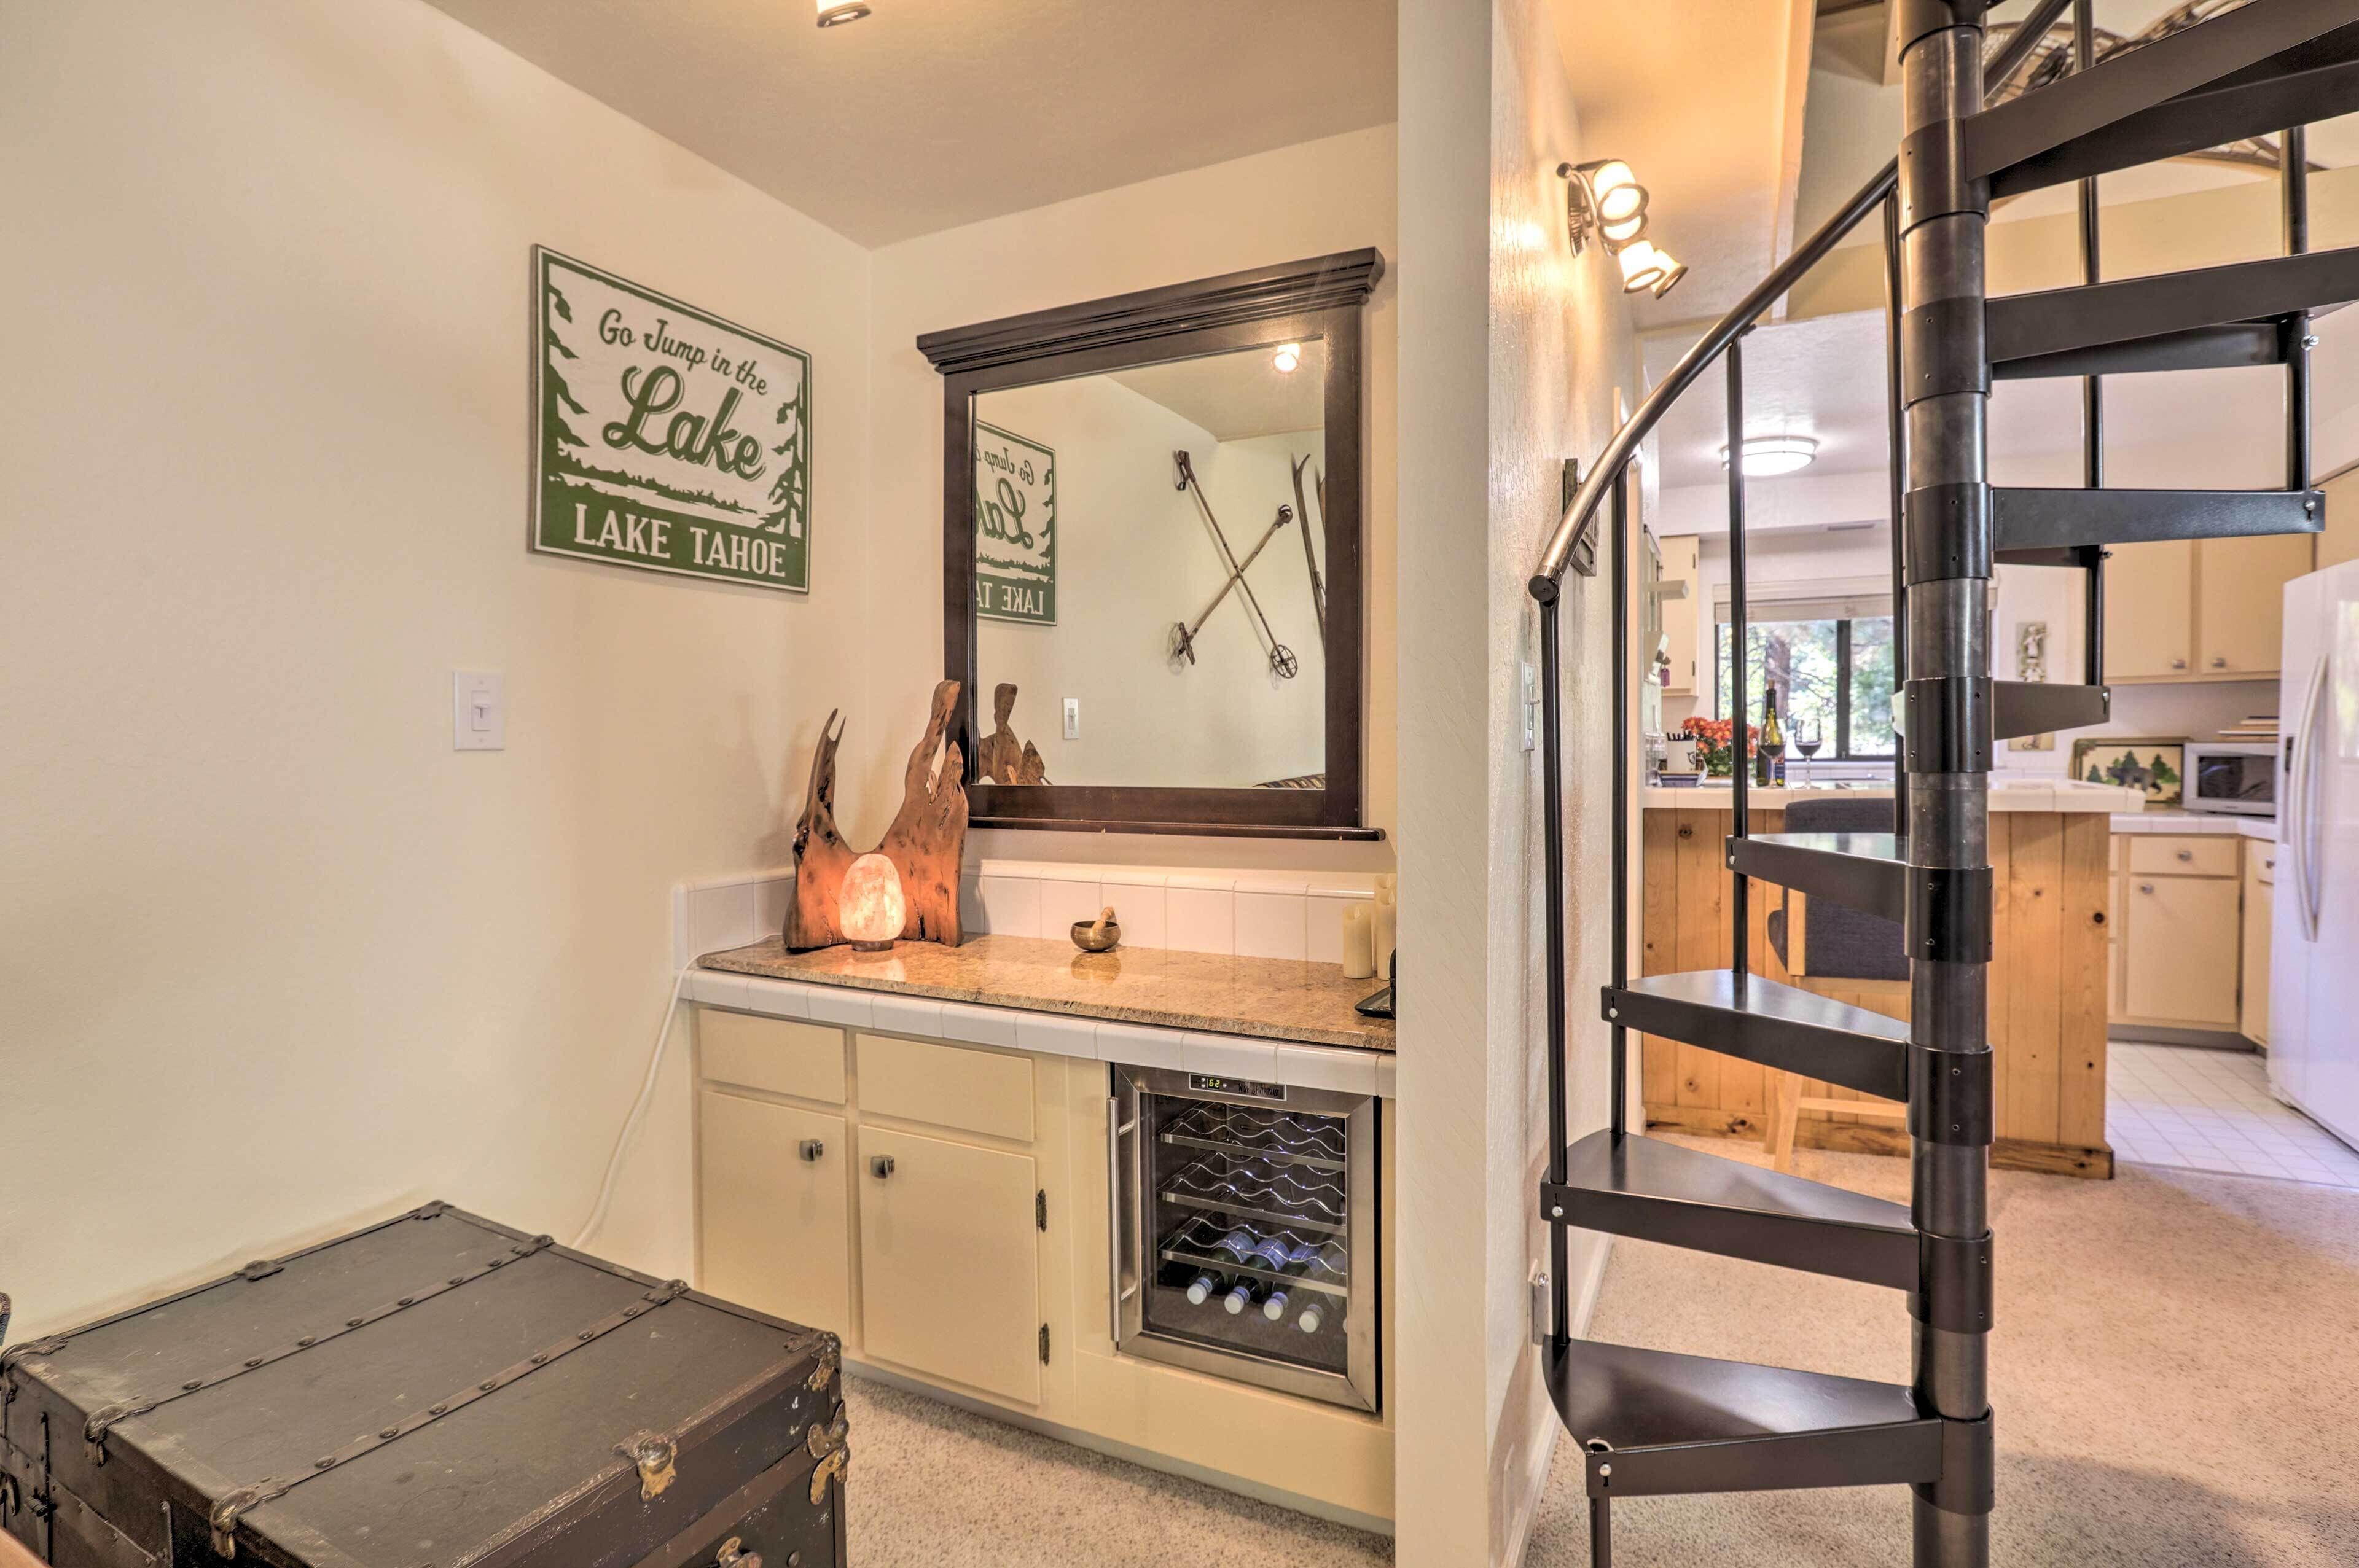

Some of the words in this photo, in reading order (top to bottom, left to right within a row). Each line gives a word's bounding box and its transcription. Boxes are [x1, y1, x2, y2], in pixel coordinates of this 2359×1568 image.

[599, 308, 636, 347] Go
[644, 318, 707, 372] Jump
[711, 348, 732, 376] in
[735, 360, 768, 396] the
[602, 365, 767, 482] Lake
[574, 503, 671, 559] LAKE
[690, 526, 786, 577] TAHOE
[1208, 1079, 1220, 1088] 62
